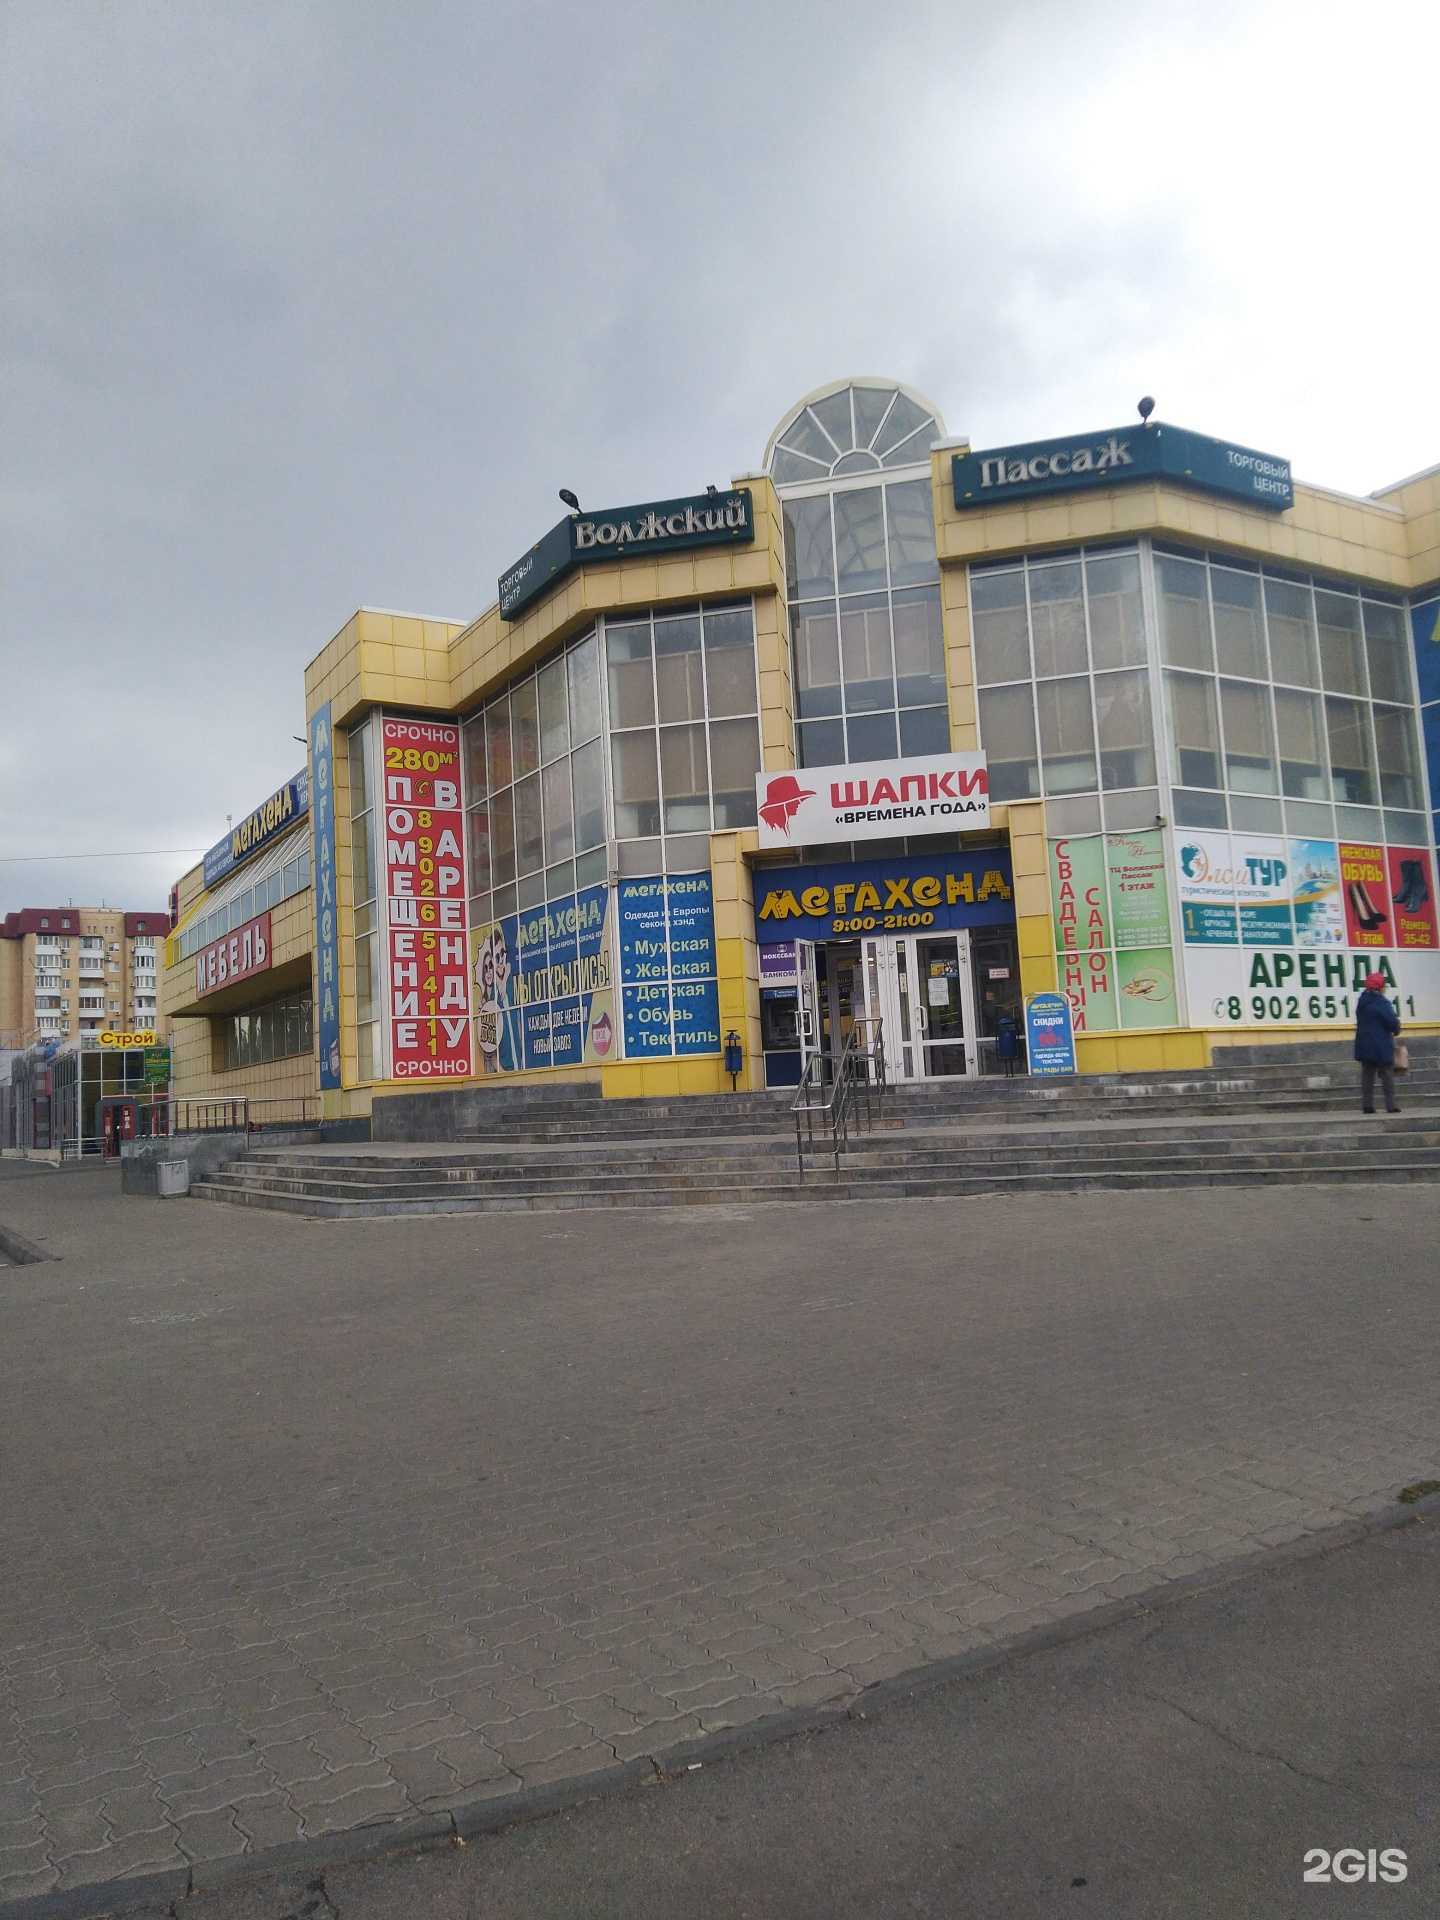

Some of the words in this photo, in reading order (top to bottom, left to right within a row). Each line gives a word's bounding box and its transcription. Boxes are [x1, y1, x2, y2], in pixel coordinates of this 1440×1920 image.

[979, 437, 1133, 488] Пассаж
[1227, 451, 1289, 478] ТОРГОВЫЙ
[1254, 477, 1289, 495] ЦЕНТР
[575, 499, 747, 549] Волжский
[500, 559, 533, 594] ТОРГОВЫЙ
[501, 586, 520, 610] ЦЕНТР
[385, 723, 456, 743] СРОЧНО
[830, 768, 989, 808] ШАПКИ
[835, 806, 926, 824] «ВРЕМЕНА
[930, 801, 986, 816] ГОДА»
[1343, 863, 1383, 881] ОБУВЬ
[1119, 882, 1125, 892] 1
[387, 775, 419, 1048] ПОМЕЩЕНИЕ
[624, 911, 659, 920] Одежда
[673, 907, 710, 917] Европы
[673, 918, 695, 926] хэнд
[832, 912, 935, 933] 9:00-21:00
[1085, 887, 1107, 993] САЛОН
[1355, 931, 1360, 944] 1
[635, 938, 709, 957] Мужская
[197, 925, 267, 993] МЕБЕЛЬ
[635, 962, 710, 978] Женская
[763, 970, 805, 979] БАНКОМТ
[1249, 953, 1397, 992] АРЕНДА
[637, 984, 705, 1002] Детская
[638, 1008, 693, 1025] Обувь
[1228, 996, 1241, 1020] 8
[1252, 996, 1300, 1019] 902
[1309, 995, 1350, 1018] 651
[1033, 1017, 1063, 1026] СКИДКИ
[101, 1032, 153, 1047] Строй
[639, 1031, 718, 1046] Текстиль
[395, 1059, 468, 1075] СРОЧНО
